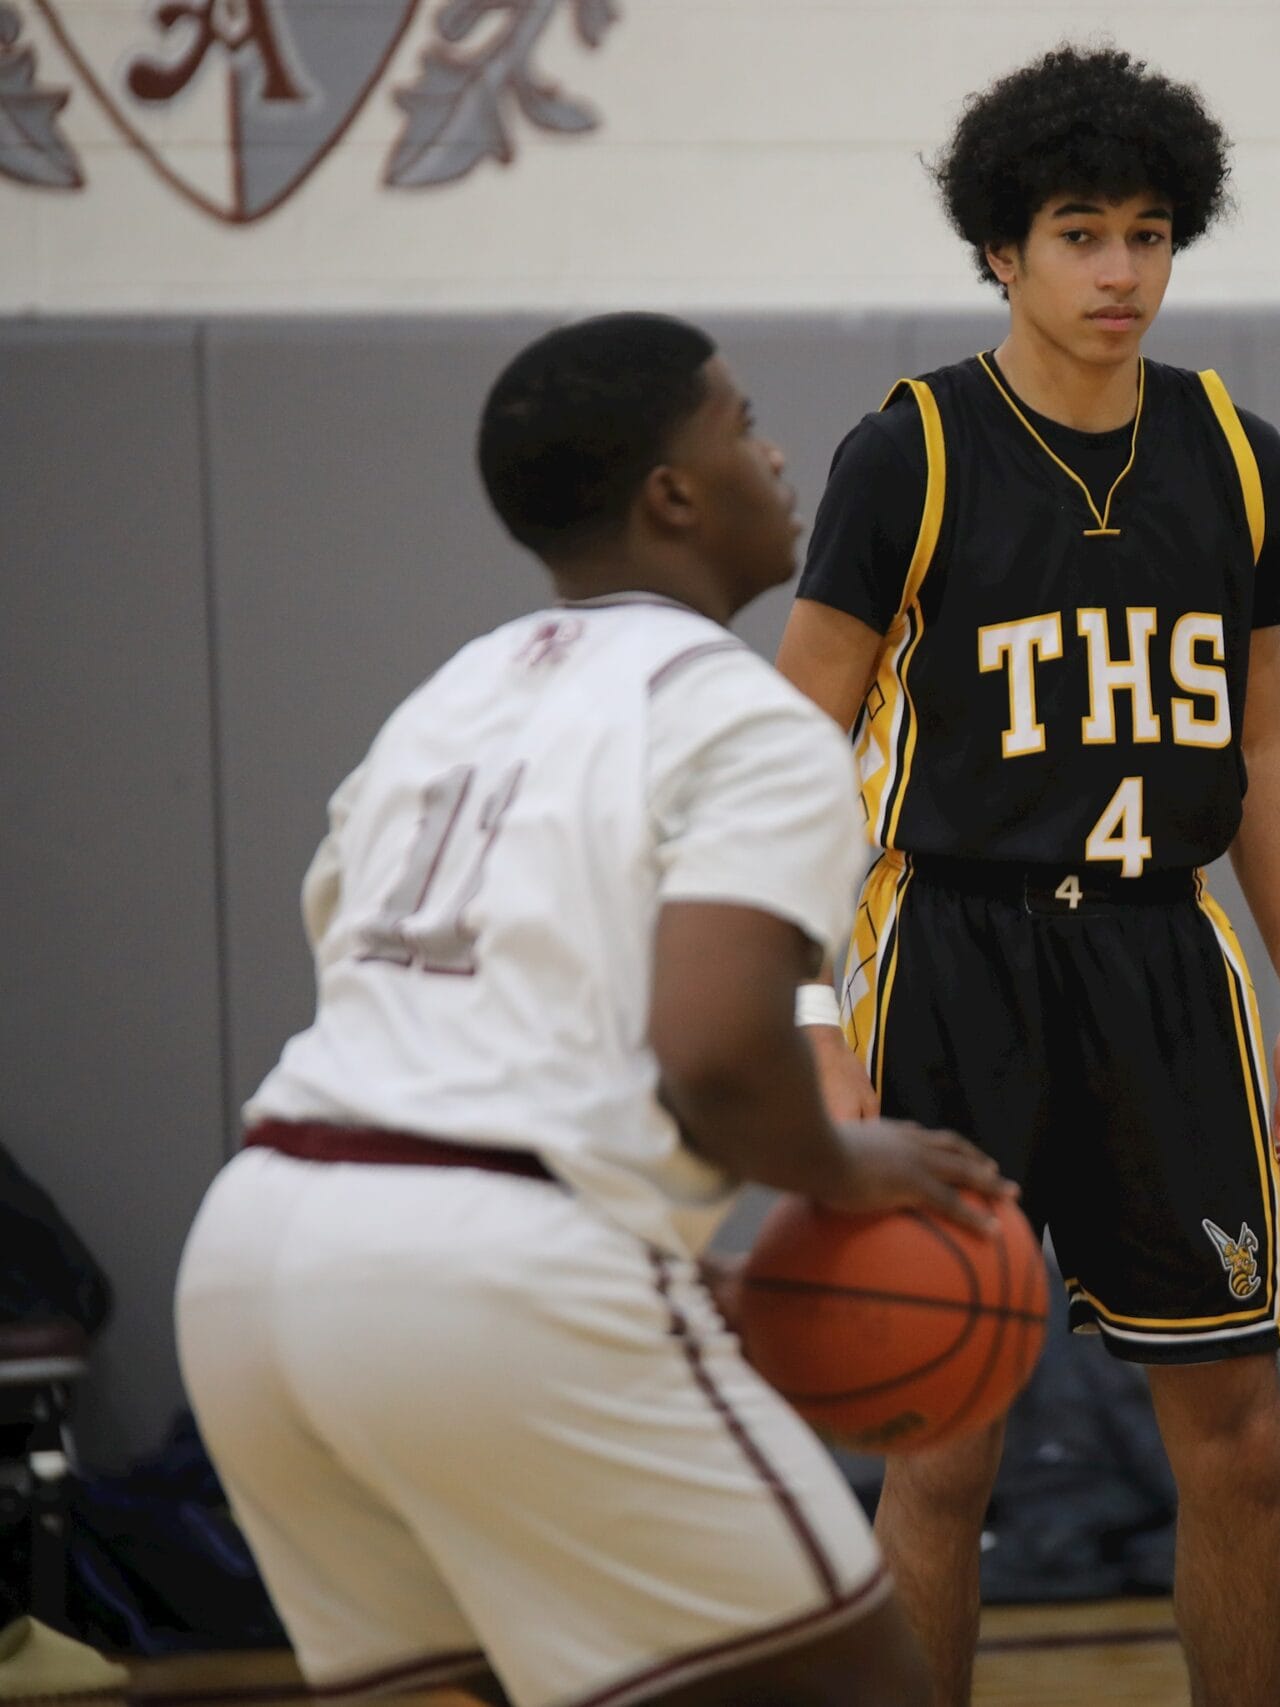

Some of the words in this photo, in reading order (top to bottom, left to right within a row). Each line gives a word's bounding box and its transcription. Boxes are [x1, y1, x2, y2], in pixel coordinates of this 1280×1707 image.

[978, 607, 1232, 759] THS
[1085, 776, 1152, 878] 4
[1055, 875, 1083, 909] 4
